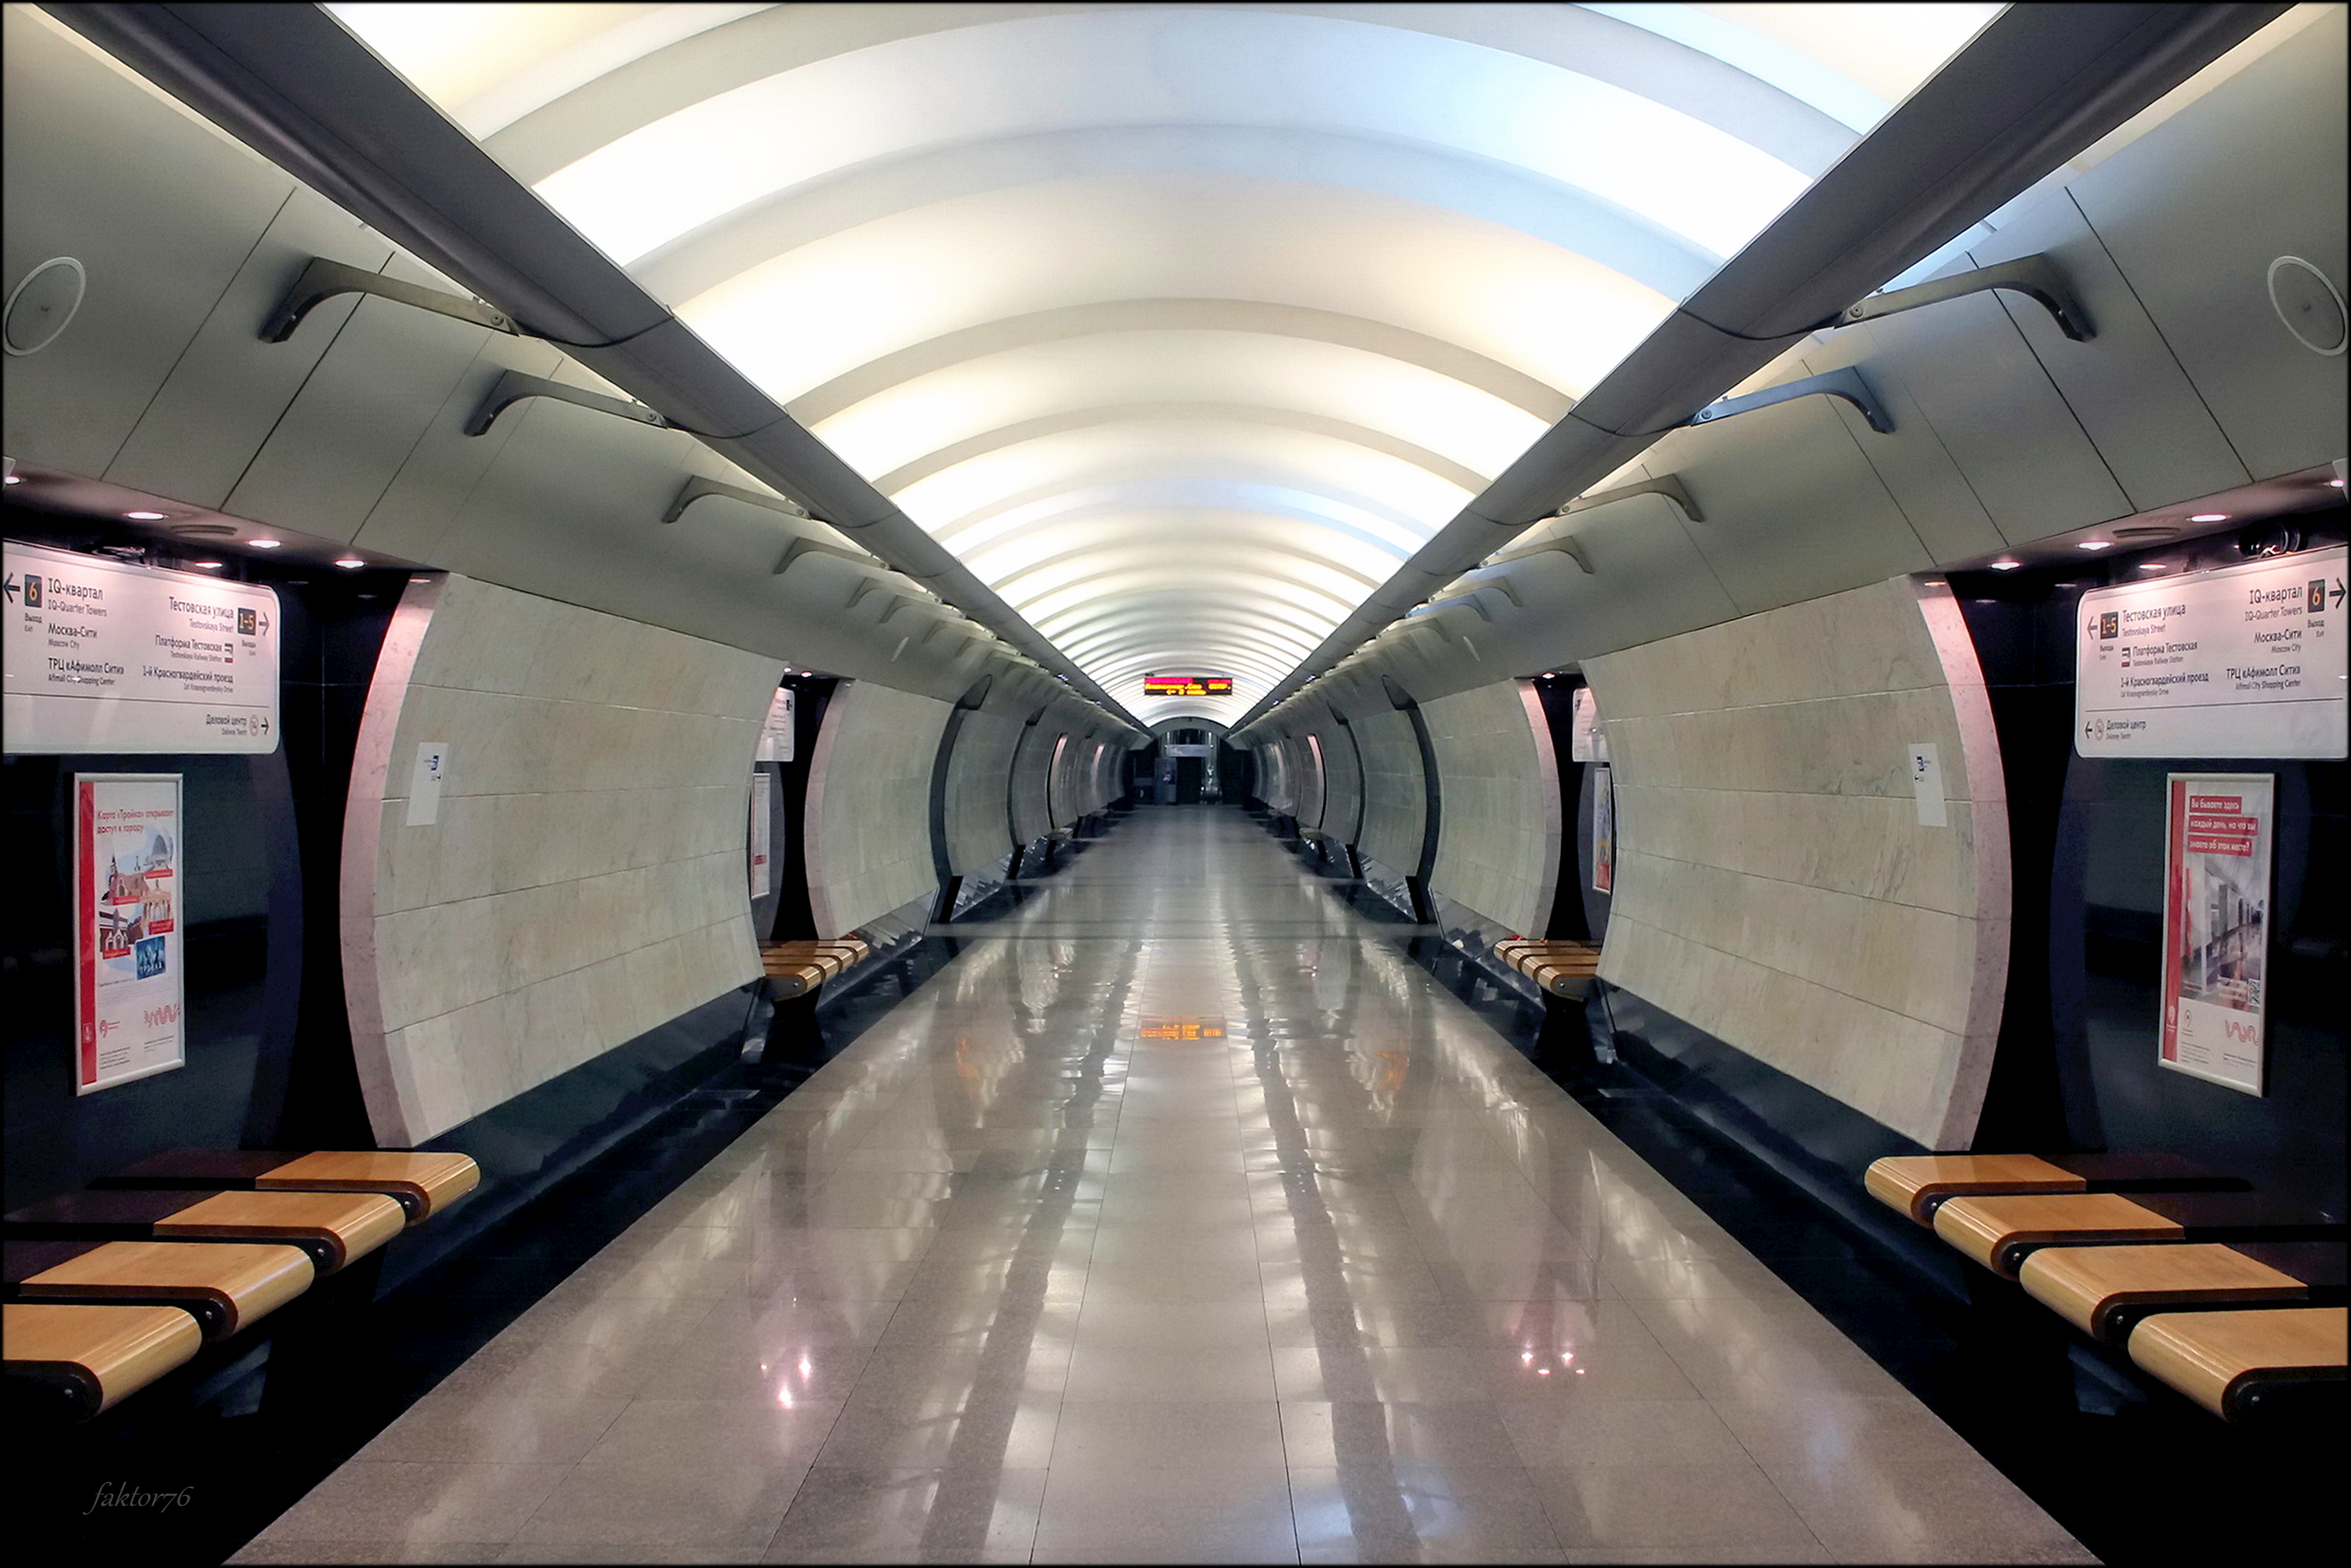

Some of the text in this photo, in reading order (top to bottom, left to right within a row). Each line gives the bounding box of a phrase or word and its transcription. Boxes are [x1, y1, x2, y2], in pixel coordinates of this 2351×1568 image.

[29, 582, 38, 601] 6
[48, 578, 103, 601] IQ-квартал
[2249, 587, 2302, 604] IQ-квартал
[2313, 587, 2320, 606] 6
[48, 599, 107, 617] IQ-Quarter Towers
[169, 596, 234, 620] Тестовская улица
[2122, 604, 2186, 623] Тестовская улица
[2244, 607, 2302, 621] IQ-Quarter Towers
[48, 623, 98, 639] Москва-Сити
[240, 613, 254, 632] 1-5
[2102, 617, 2117, 634] 1-5
[155, 635, 222, 652] Платформа Тестовская
[2254, 628, 2302, 643] Москва-Сити
[2132, 641, 2198, 657] Платформа Тестовская
[48, 658, 64, 672] ТРЦ
[2226, 668, 2241, 680] ТРЦ
